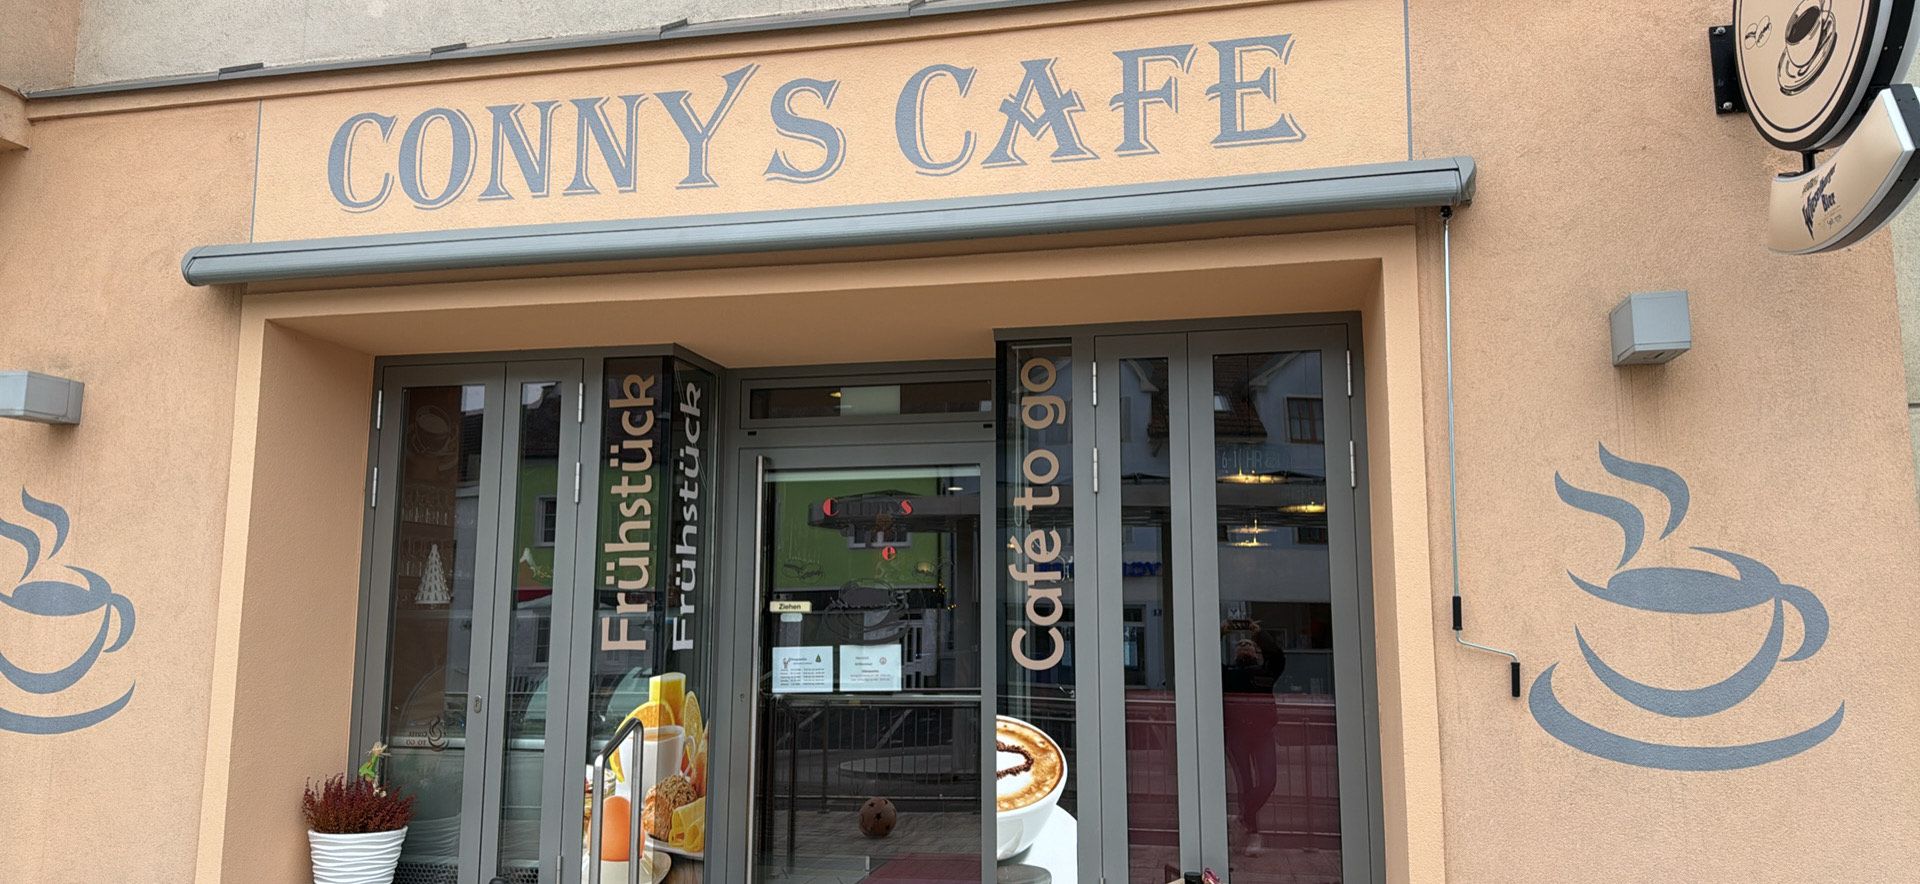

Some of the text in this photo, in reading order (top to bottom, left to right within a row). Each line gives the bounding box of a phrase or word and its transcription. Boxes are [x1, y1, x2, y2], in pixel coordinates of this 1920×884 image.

[895, 33, 1306, 176] CAFE
[1020, 357, 1066, 430] go
[601, 373, 655, 651] Frühstück
[672, 382, 701, 651] Frühstück
[1013, 449, 1060, 511] to
[1008, 535, 1065, 671] Café
